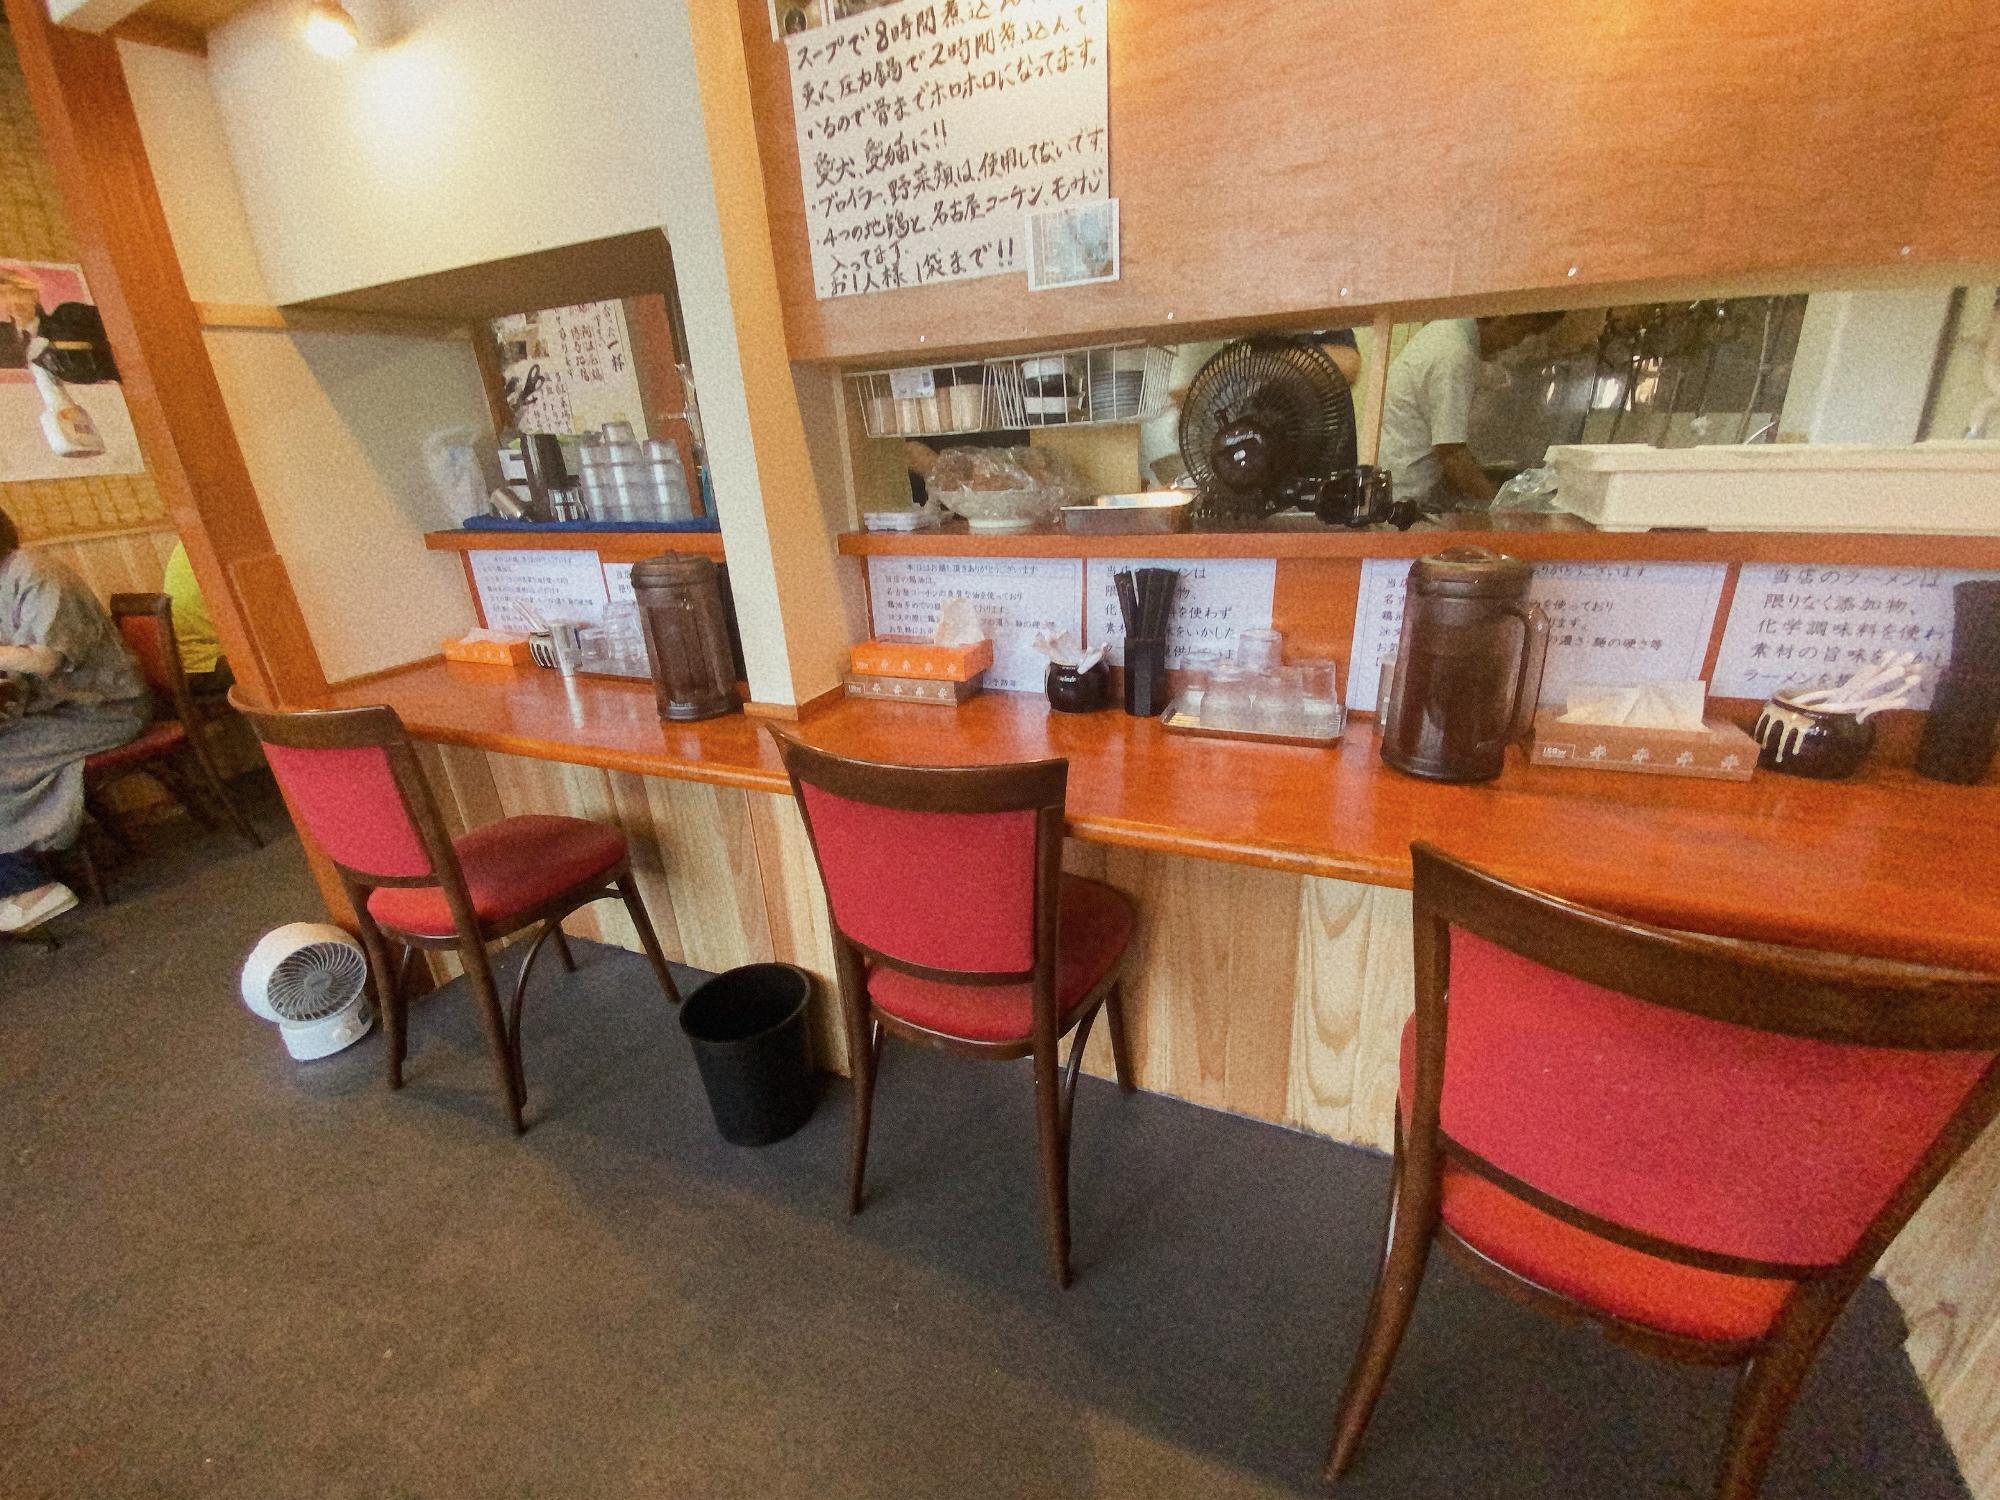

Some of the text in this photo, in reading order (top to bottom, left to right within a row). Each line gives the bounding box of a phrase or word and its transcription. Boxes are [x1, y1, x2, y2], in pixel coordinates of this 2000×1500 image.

[1758, 618, 1948, 642] 化学調味料を使わ
